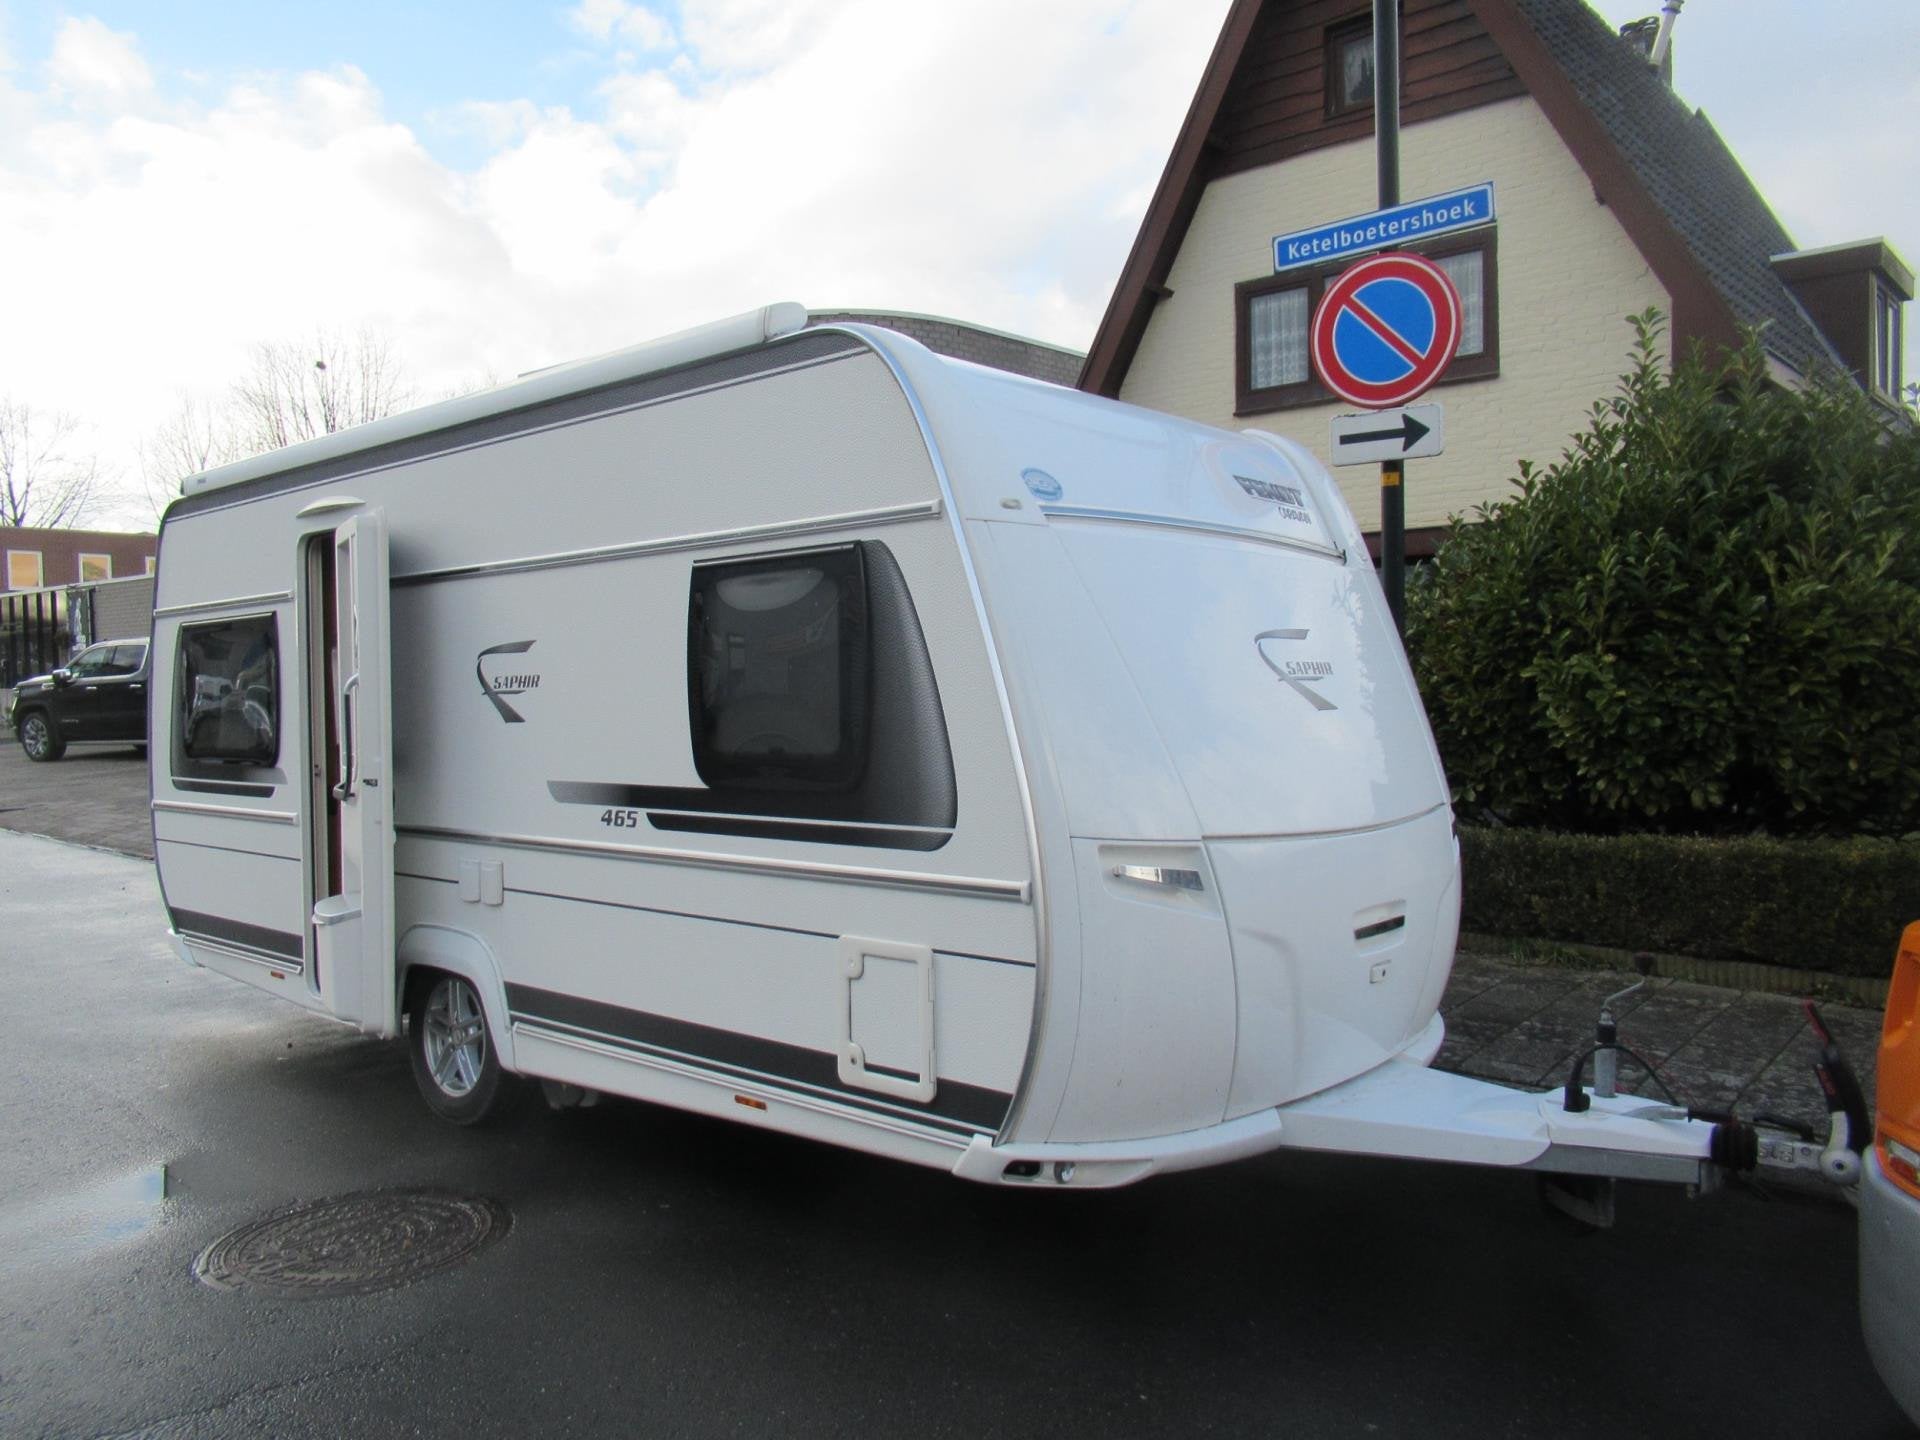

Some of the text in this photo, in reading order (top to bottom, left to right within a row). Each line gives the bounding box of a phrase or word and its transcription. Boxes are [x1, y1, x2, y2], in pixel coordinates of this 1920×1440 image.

[1288, 199, 1477, 260] Ketelboetershoek
[1286, 661, 1334, 676] SAPHIR
[493, 674, 541, 689] SAPHIR
[600, 809, 639, 828] 465
